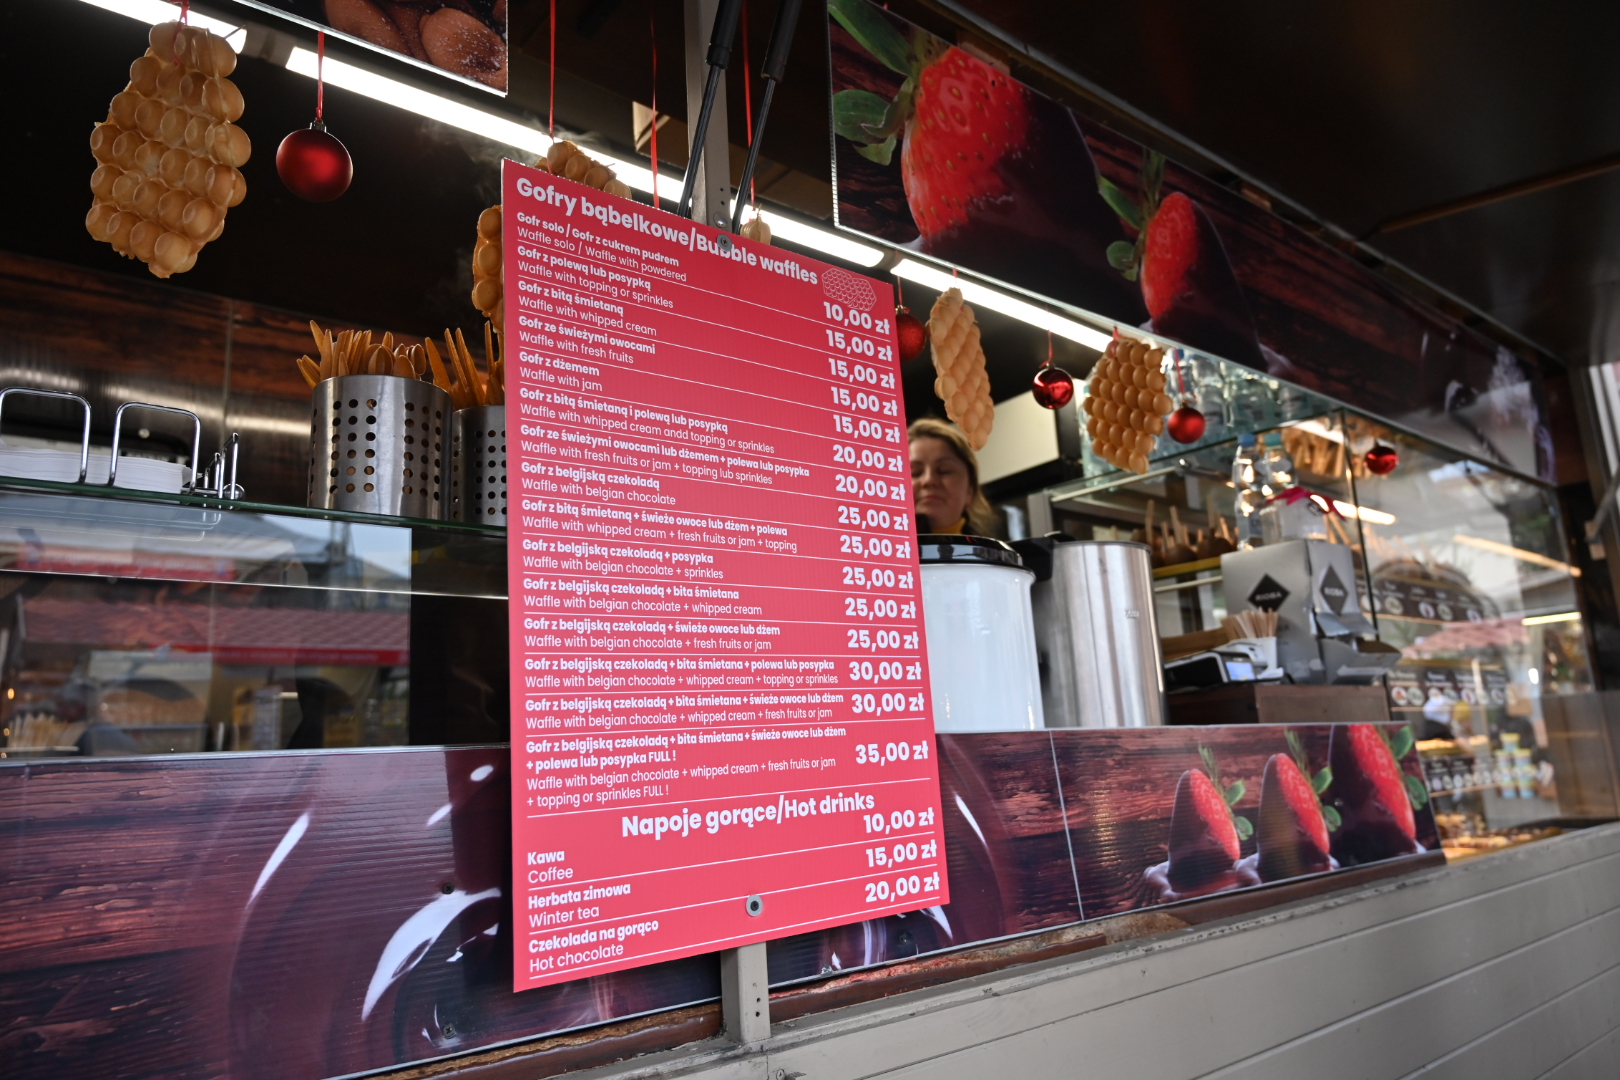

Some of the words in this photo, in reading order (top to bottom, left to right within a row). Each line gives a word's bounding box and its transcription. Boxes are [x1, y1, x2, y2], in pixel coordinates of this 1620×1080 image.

[516, 177, 578, 217] Gofry
[759, 255, 818, 285] waffles
[516, 211, 541, 227] Gofr
[542, 220, 565, 234] solo
[571, 227, 595, 243] Gofr
[601, 238, 641, 256] cukrem
[641, 249, 680, 267] pudrem
[517, 226, 552, 245] Waffle
[554, 238, 576, 252] solo
[584, 245, 617, 263] Waffle
[618, 256, 639, 269] with
[641, 263, 687, 282] powdered
[517, 245, 542, 260] Gofr
[550, 255, 589, 276] polewą
[590, 264, 607, 278] lub
[608, 271, 652, 292] posypką
[517, 260, 553, 278] Waffle
[554, 271, 577, 284] with
[578, 276, 618, 298] topping
[619, 288, 631, 298] or
[632, 291, 674, 309] sprinkles
[518, 280, 543, 295] Gofr
[551, 287, 573, 305] bitą
[574, 293, 624, 318] śmietaną
[518, 295, 553, 313] Waffle
[555, 305, 578, 318] with
[579, 311, 624, 329] whipped
[625, 322, 657, 337] cream
[823, 300, 873, 330] 10,00
[874, 318, 891, 336] zł
[518, 315, 544, 330] Gofr
[544, 322, 557, 333] ze
[558, 323, 608, 344] świeżymi
[609, 337, 656, 355] owocami
[519, 330, 555, 348] Waffle
[556, 339, 579, 353] with
[580, 343, 607, 358] fresh
[608, 349, 634, 364] fruits
[825, 328, 875, 357] 15,00
[877, 344, 893, 362] zł
[519, 351, 544, 365] Gofr
[552, 358, 600, 377] dżemem
[519, 366, 555, 383] Waffle
[557, 374, 580, 388] with
[581, 377, 603, 392] jam
[828, 357, 878, 385] 15,00
[879, 372, 896, 390] zł
[519, 387, 545, 401] Gofr
[553, 392, 576, 410] bitą
[577, 396, 629, 419] śmietaną
[634, 408, 671, 426] polewą
[671, 413, 688, 426] lub
[687, 418, 729, 435] posypką
[830, 386, 880, 413] 15,00
[882, 399, 899, 417] zł
[520, 403, 556, 419] Waffle
[558, 410, 581, 423] with
[582, 414, 628, 431] whipped
[629, 423, 662, 436] cream
[663, 428, 689, 440] andd
[690, 431, 726, 449] topping
[727, 438, 737, 447] or
[737, 440, 775, 454] sprinkles
[832, 414, 883, 440] 15,00
[884, 426, 901, 444] zł
[832, 443, 885, 469] 20,00
[887, 454, 904, 473] zł
[521, 461, 547, 475] Gofr
[555, 465, 606, 485] belgijską
[607, 474, 660, 492] czekoladą
[521, 477, 558, 492] Waffle
[560, 482, 583, 495] with
[585, 484, 625, 502] belgian
[627, 490, 676, 506] chocolate
[834, 473, 888, 499] 20,00
[890, 483, 906, 502] zł
[837, 505, 891, 530] 25,00
[893, 513, 909, 531] zł
[839, 534, 893, 559] 25,00
[895, 540, 912, 559] zł
[523, 555, 559, 569] Waffle
[560, 558, 583, 570] with
[585, 559, 624, 575] belgian
[625, 562, 674, 576] chocolate
[684, 566, 724, 580] sprinkles
[842, 565, 896, 590] 25,00
[897, 571, 914, 590] zł
[844, 597, 898, 621] 25,00
[900, 600, 917, 619] zł
[846, 628, 901, 652] 25,00
[903, 630, 920, 650] zł
[848, 661, 904, 684] 30,00
[905, 661, 923, 681] zł
[525, 697, 552, 712] Gofr
[560, 696, 612, 714] belgijską
[613, 696, 667, 711] czekoladą
[675, 694, 696, 707] bita
[696, 694, 742, 707] śmietana
[749, 692, 779, 705] świeże
[779, 695, 807, 704] owoce
[807, 692, 822, 704] lub
[821, 692, 844, 703] dżem
[851, 692, 906, 717] 30,00
[908, 692, 925, 712] zł
[855, 741, 911, 767] 35,00
[912, 739, 929, 760] zł
[536, 791, 581, 810] topping
[582, 792, 594, 803] or
[596, 786, 642, 805] sprinkles
[643, 784, 665, 797] FULL
[621, 807, 703, 841] Napoje
[819, 791, 875, 815] drinks
[863, 809, 916, 835] 10,00
[917, 806, 935, 827] zł
[527, 850, 565, 866] Kawa
[865, 842, 918, 869] 15,00
[920, 838, 938, 859] zł
[527, 866, 574, 884] Coffee
[864, 874, 921, 903] 20,00
[923, 871, 941, 892] zł
[528, 890, 582, 910] Herbata
[582, 883, 631, 901] zimowa
[528, 910, 575, 928] Winter
[577, 906, 600, 920] tea
[528, 929, 598, 954] Czekolada
[599, 927, 616, 941] na
[616, 920, 660, 942] gorąco
[529, 955, 555, 973] Hot
[556, 943, 624, 967] chocolate
